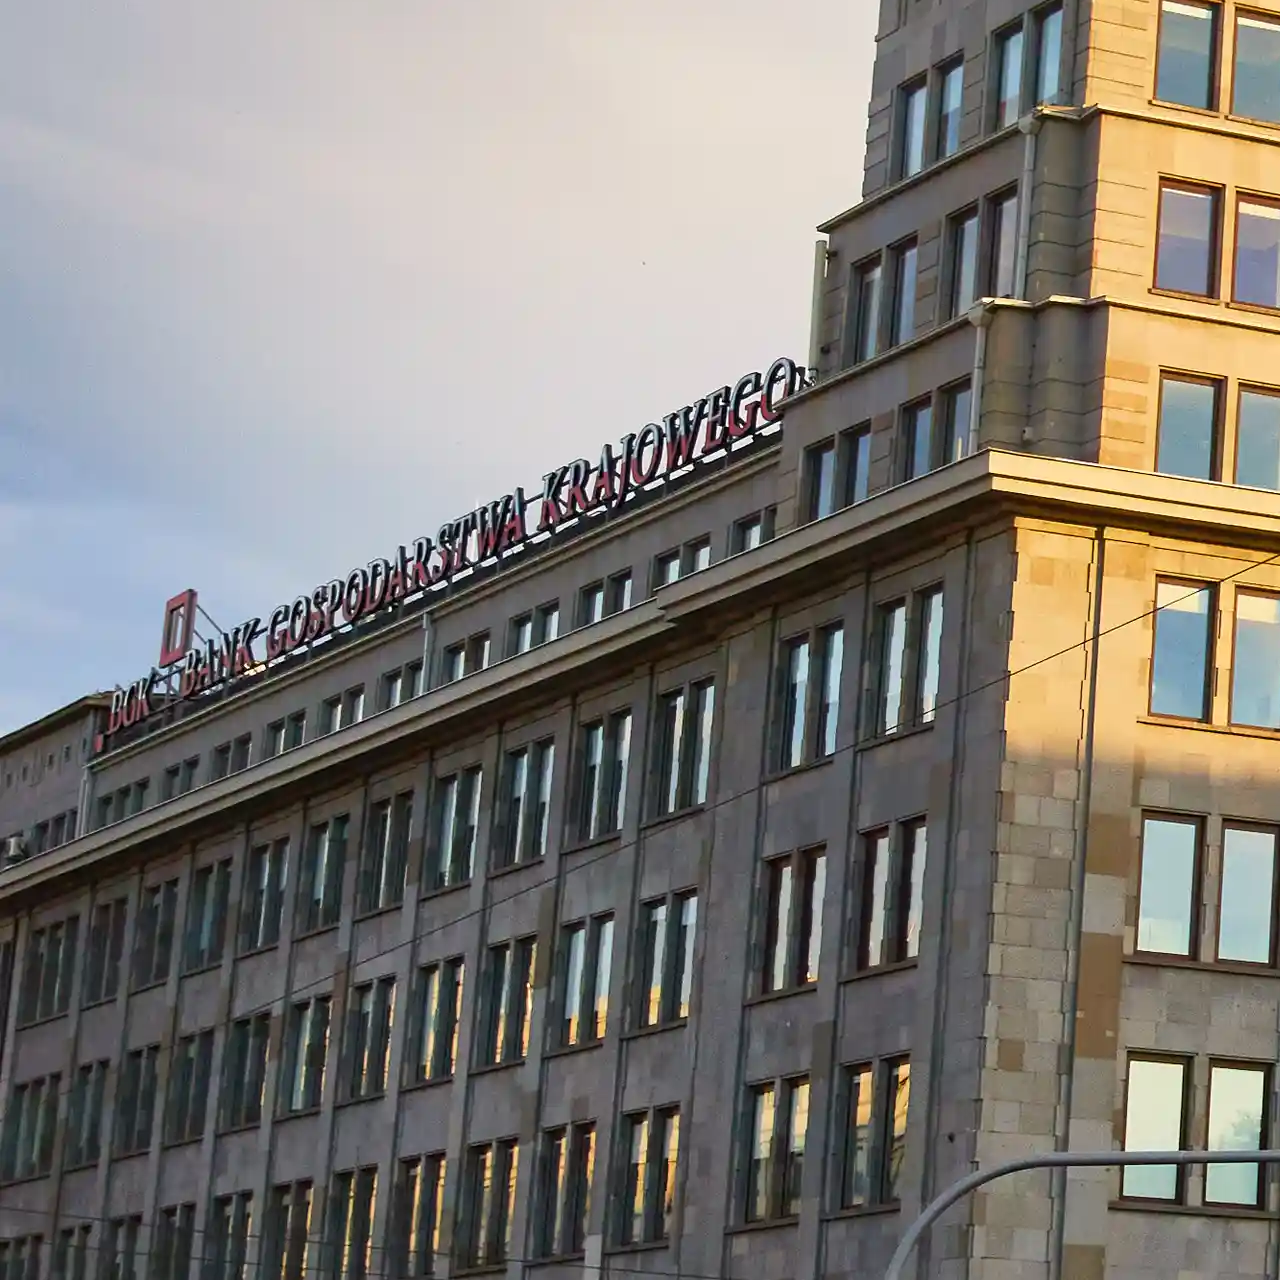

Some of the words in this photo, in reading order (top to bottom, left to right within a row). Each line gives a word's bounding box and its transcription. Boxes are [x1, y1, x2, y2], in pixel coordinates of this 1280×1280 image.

[107, 668, 156, 735] BGK
[180, 618, 261, 701] BANK
[266, 487, 528, 659] GOSPODARSTWA
[536, 357, 796, 531] KRAJOWEGO
